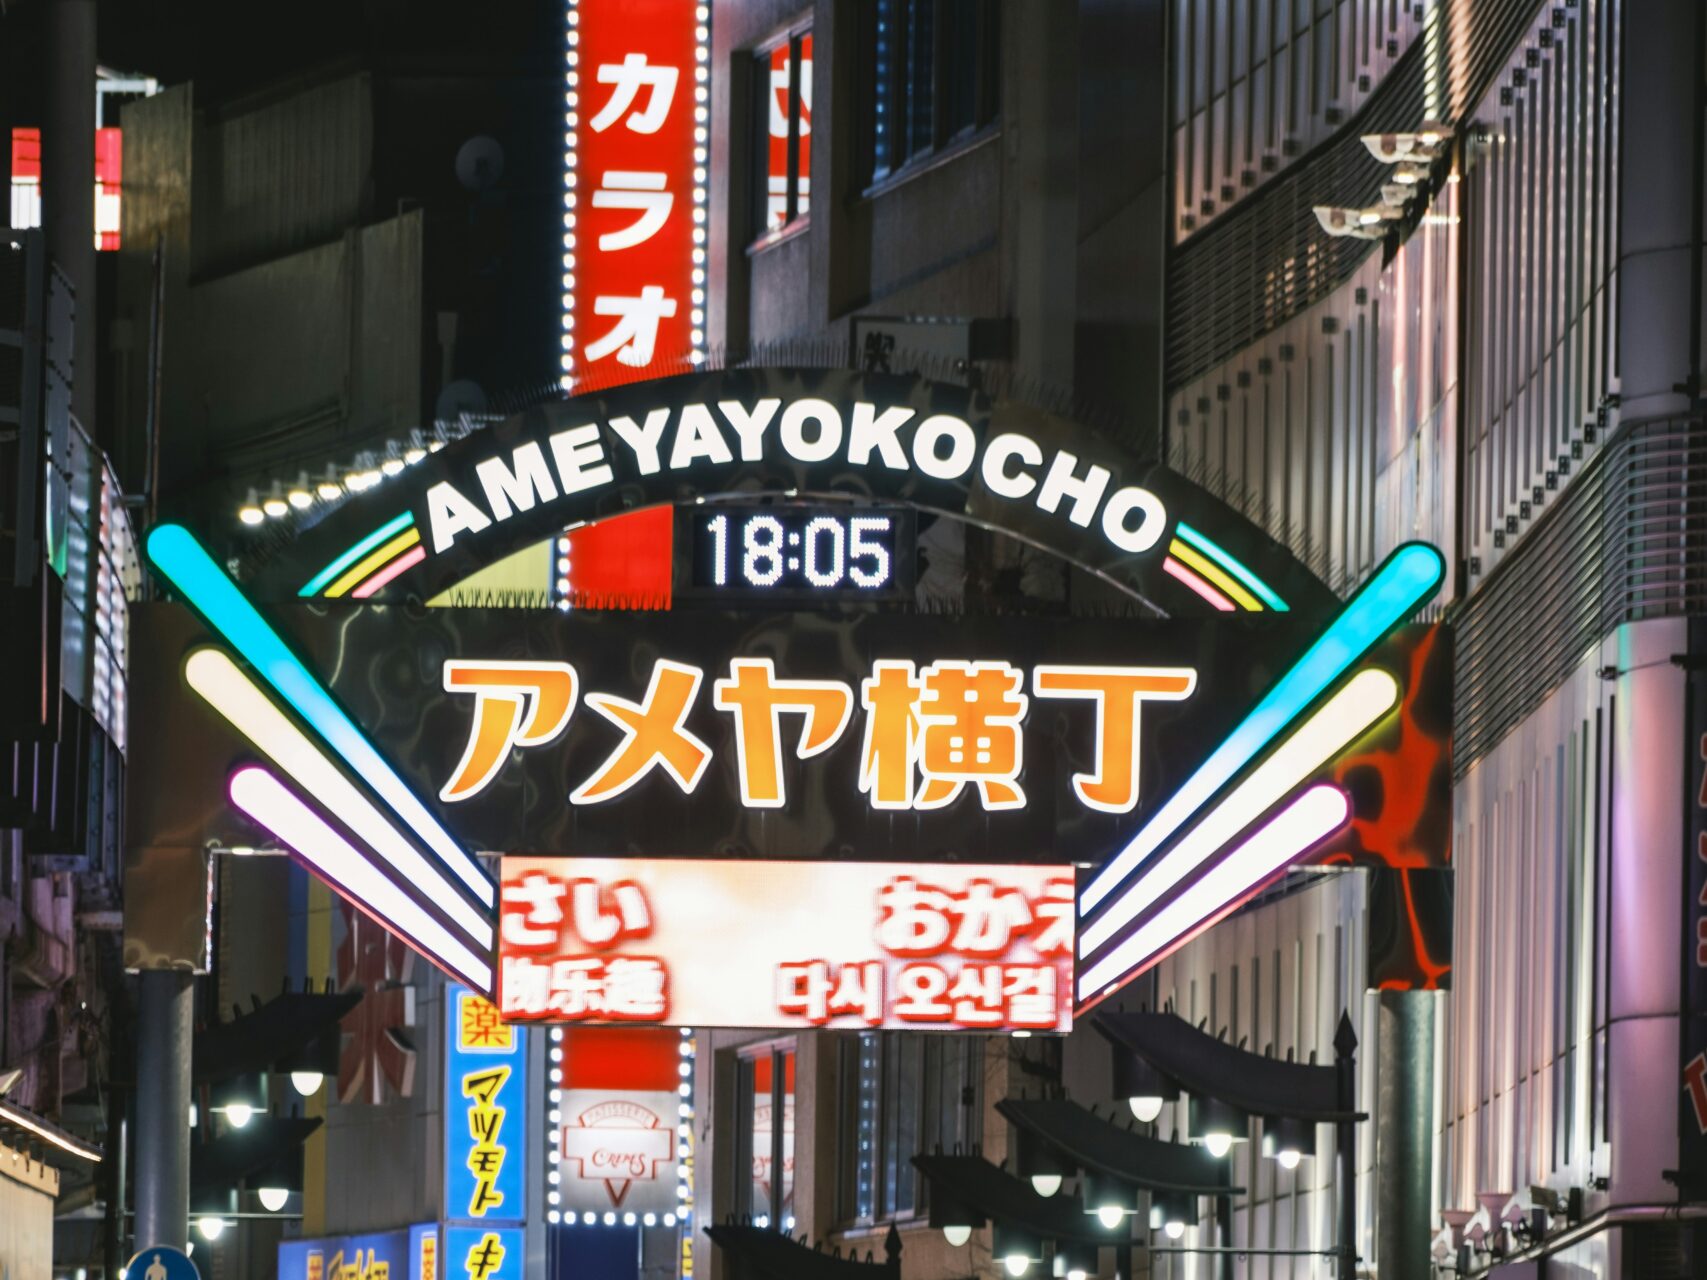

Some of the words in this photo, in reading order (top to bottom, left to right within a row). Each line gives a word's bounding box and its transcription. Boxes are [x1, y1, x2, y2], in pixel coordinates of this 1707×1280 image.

[584, 53, 679, 367] カラオ
[426, 399, 1167, 554] AMEYAYOKOCHO
[708, 515, 890, 588] 18:05
[439, 657, 1197, 813] アメヤ横丁
[778, 959, 884, 1026] 다시
[893, 961, 1058, 1028] 오신걸
